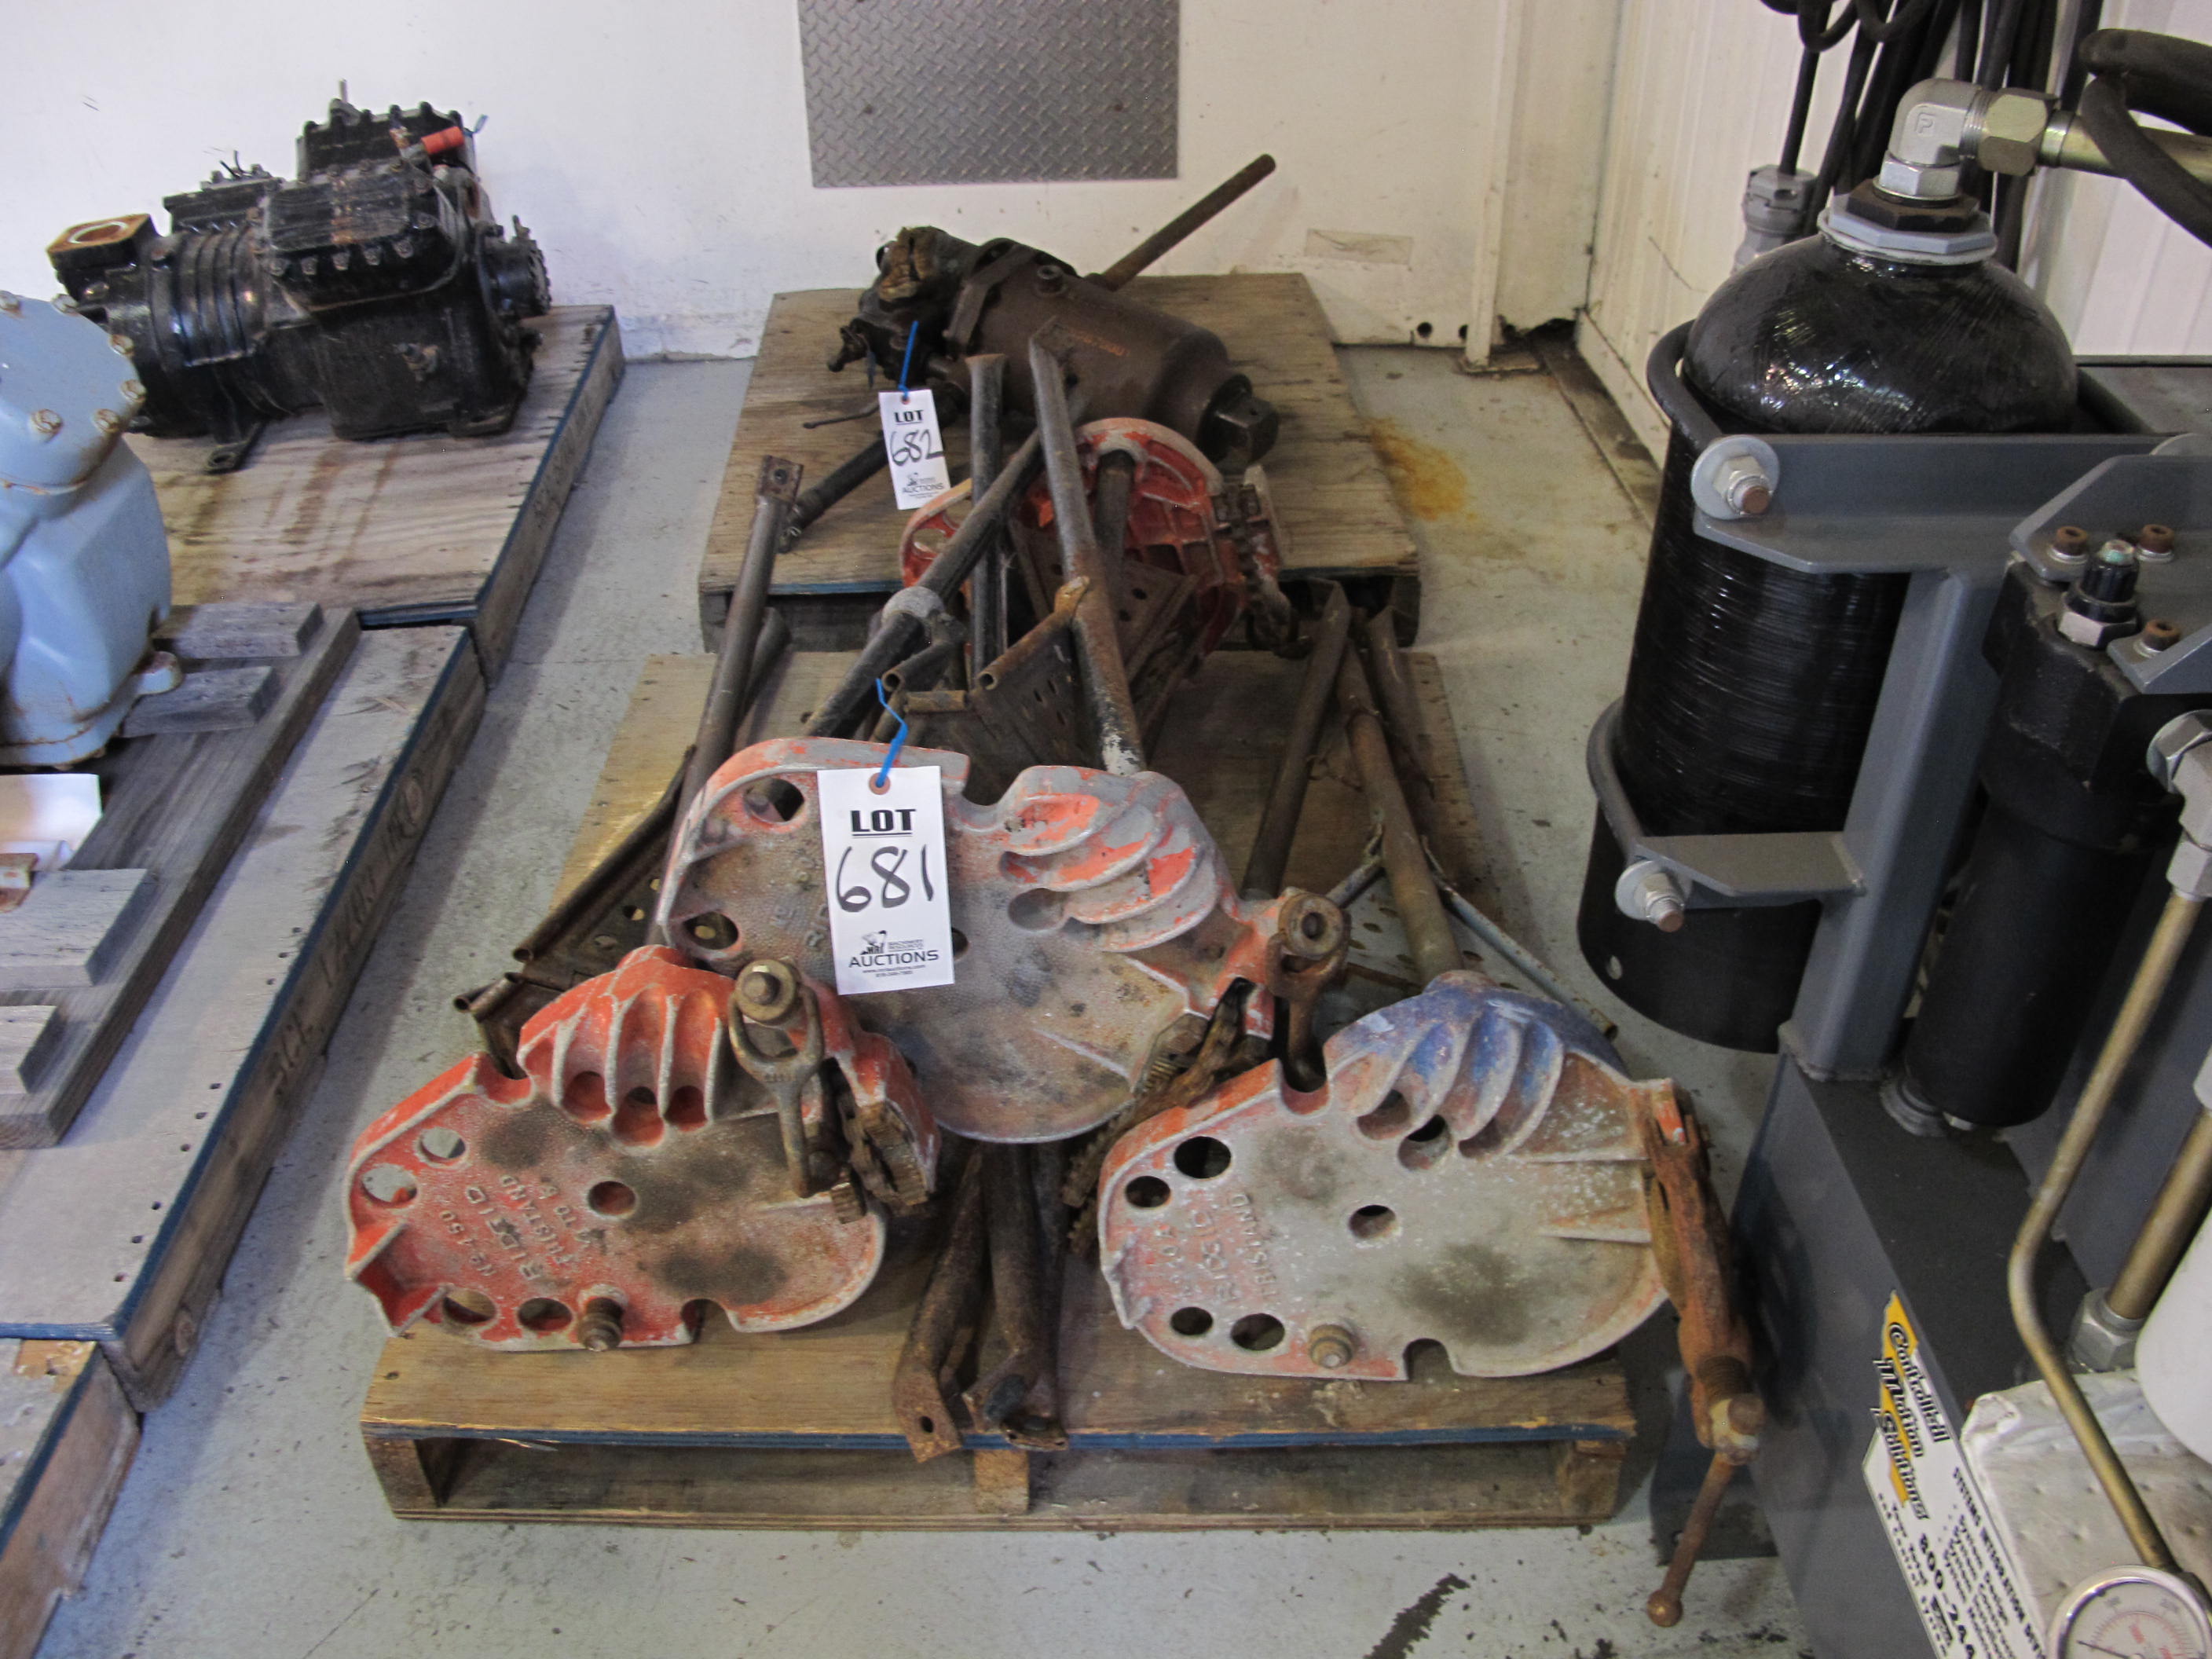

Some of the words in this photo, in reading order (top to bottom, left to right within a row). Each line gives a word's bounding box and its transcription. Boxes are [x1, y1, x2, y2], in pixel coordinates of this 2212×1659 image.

[893, 409, 925, 423] LOT
[890, 429, 945, 467] 682
[903, 482, 944, 494] AUCTIONS
[850, 808, 917, 833] LOT
[836, 844, 934, 913] 681
[848, 949, 939, 968] AUCTIONS
[1888, 1321, 1950, 1443] Controlled
[1872, 1357, 1924, 1458] Motion
[1870, 1408, 1930, 1521] Solutions
